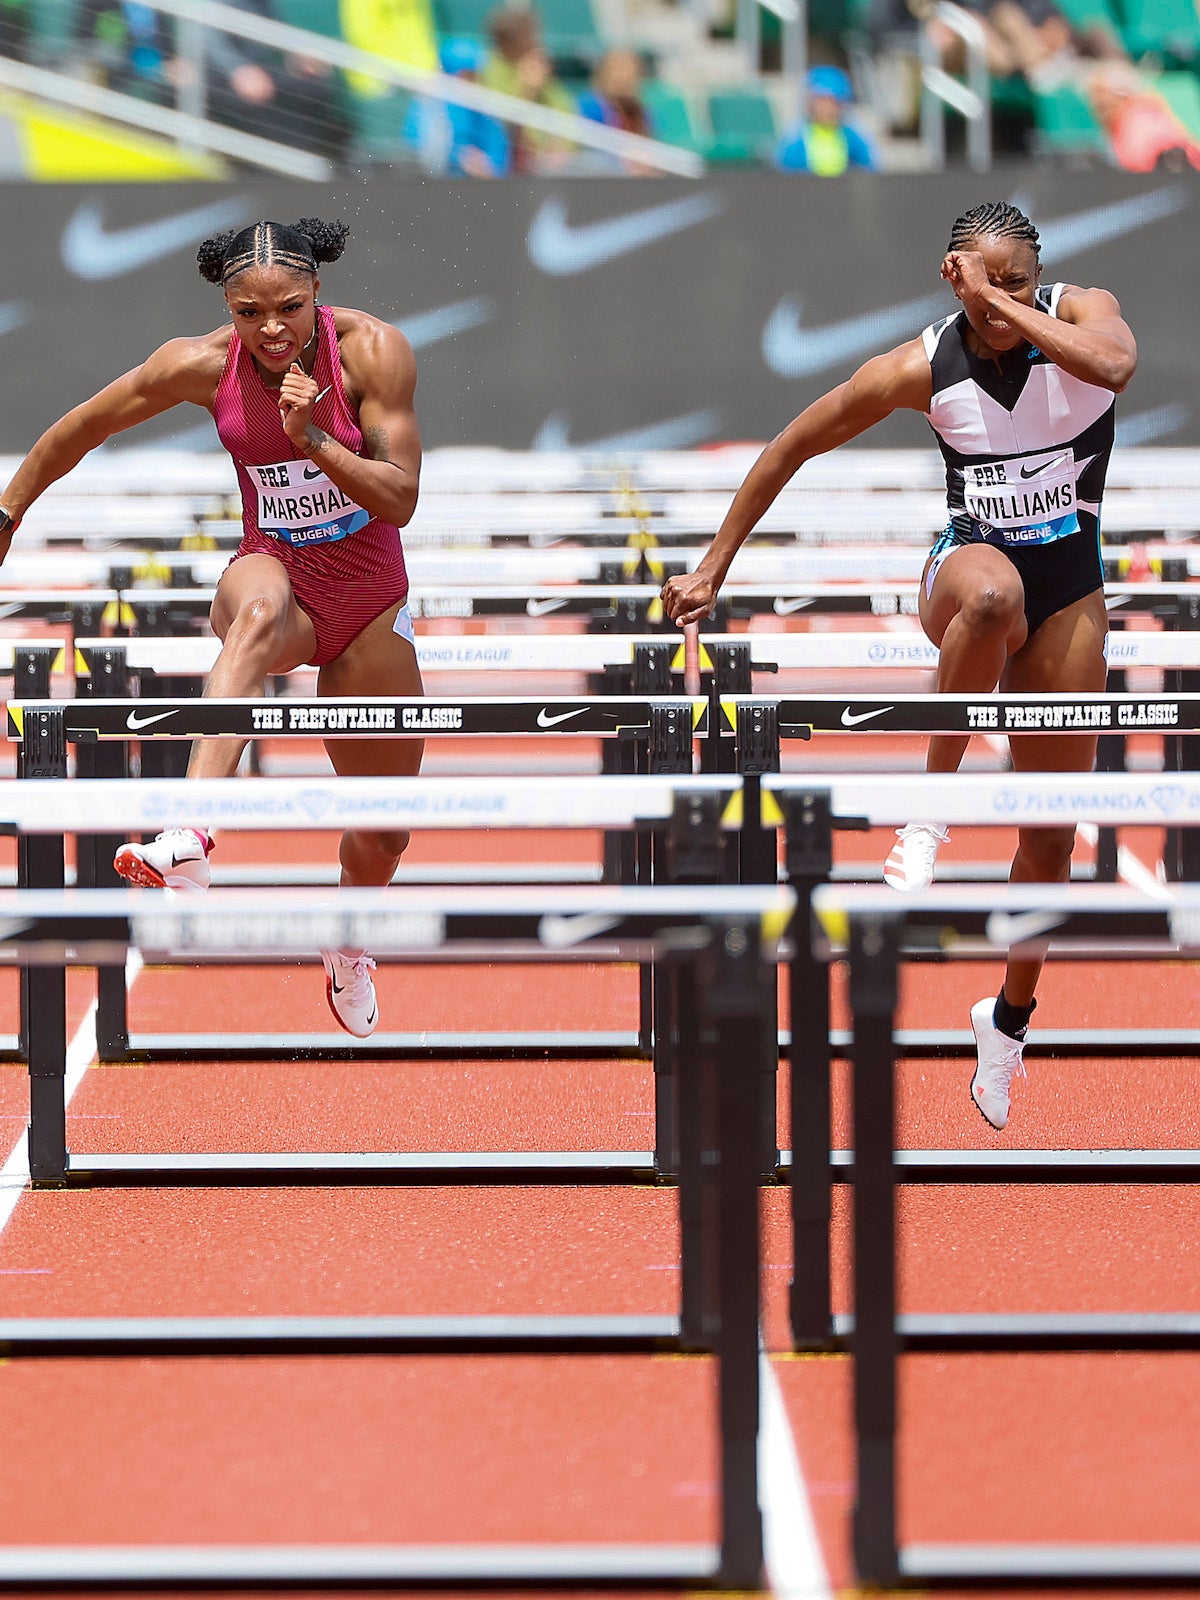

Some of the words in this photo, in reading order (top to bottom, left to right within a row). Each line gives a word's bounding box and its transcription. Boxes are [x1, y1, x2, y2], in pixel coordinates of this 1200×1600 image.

[257, 465, 290, 487] PRE
[974, 464, 1006, 487] PRE
[262, 488, 354, 521] MARSHAL
[970, 483, 1072, 519] WILLIAMS
[290, 524, 341, 542] EUGENE
[1003, 526, 1052, 541] EUGENE
[456, 648, 512, 662] LEAGUE
[251, 708, 283, 729] THE
[288, 708, 396, 729] PREFONTAINE
[402, 707, 463, 729] CLASSIC
[966, 706, 998, 728] THE
[1004, 705, 1111, 728] PREFONTAINE
[1117, 704, 1178, 725] CLASSIC
